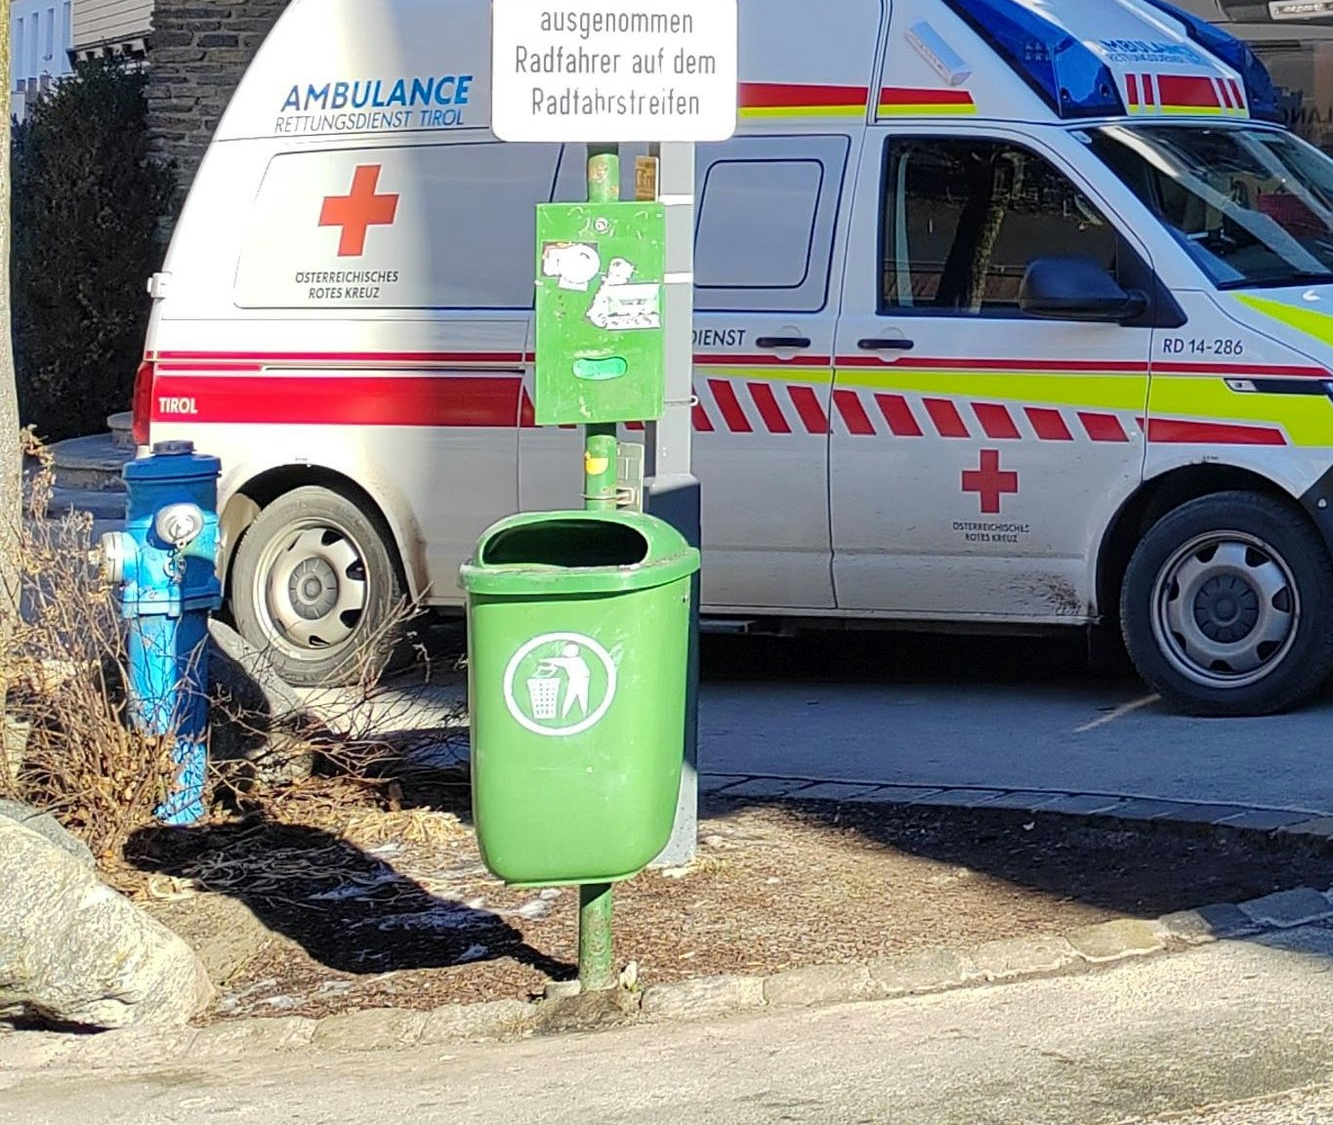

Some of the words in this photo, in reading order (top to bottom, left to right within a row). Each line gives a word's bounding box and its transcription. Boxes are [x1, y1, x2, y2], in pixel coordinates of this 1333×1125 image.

[540, 11, 694, 40] ausgenommen
[515, 45, 621, 73] Radfahrer
[632, 47, 664, 74] auf
[674, 47, 716, 74] dem
[280, 75, 473, 112] AMBULANCE
[532, 87, 700, 115] Radfahrstreifen
[275, 110, 413, 133] RETTUNGSDIENST
[420, 109, 464, 126] TIROL
[308, 287, 343, 299] ROTES
[345, 287, 380, 299] KREUZ
[1163, 338, 1184, 354] RD
[1188, 339, 1243, 355] 14-286
[158, 396, 199, 414] TIROL
[965, 532, 989, 543] ROTES
[992, 533, 1018, 543] KREUZ
